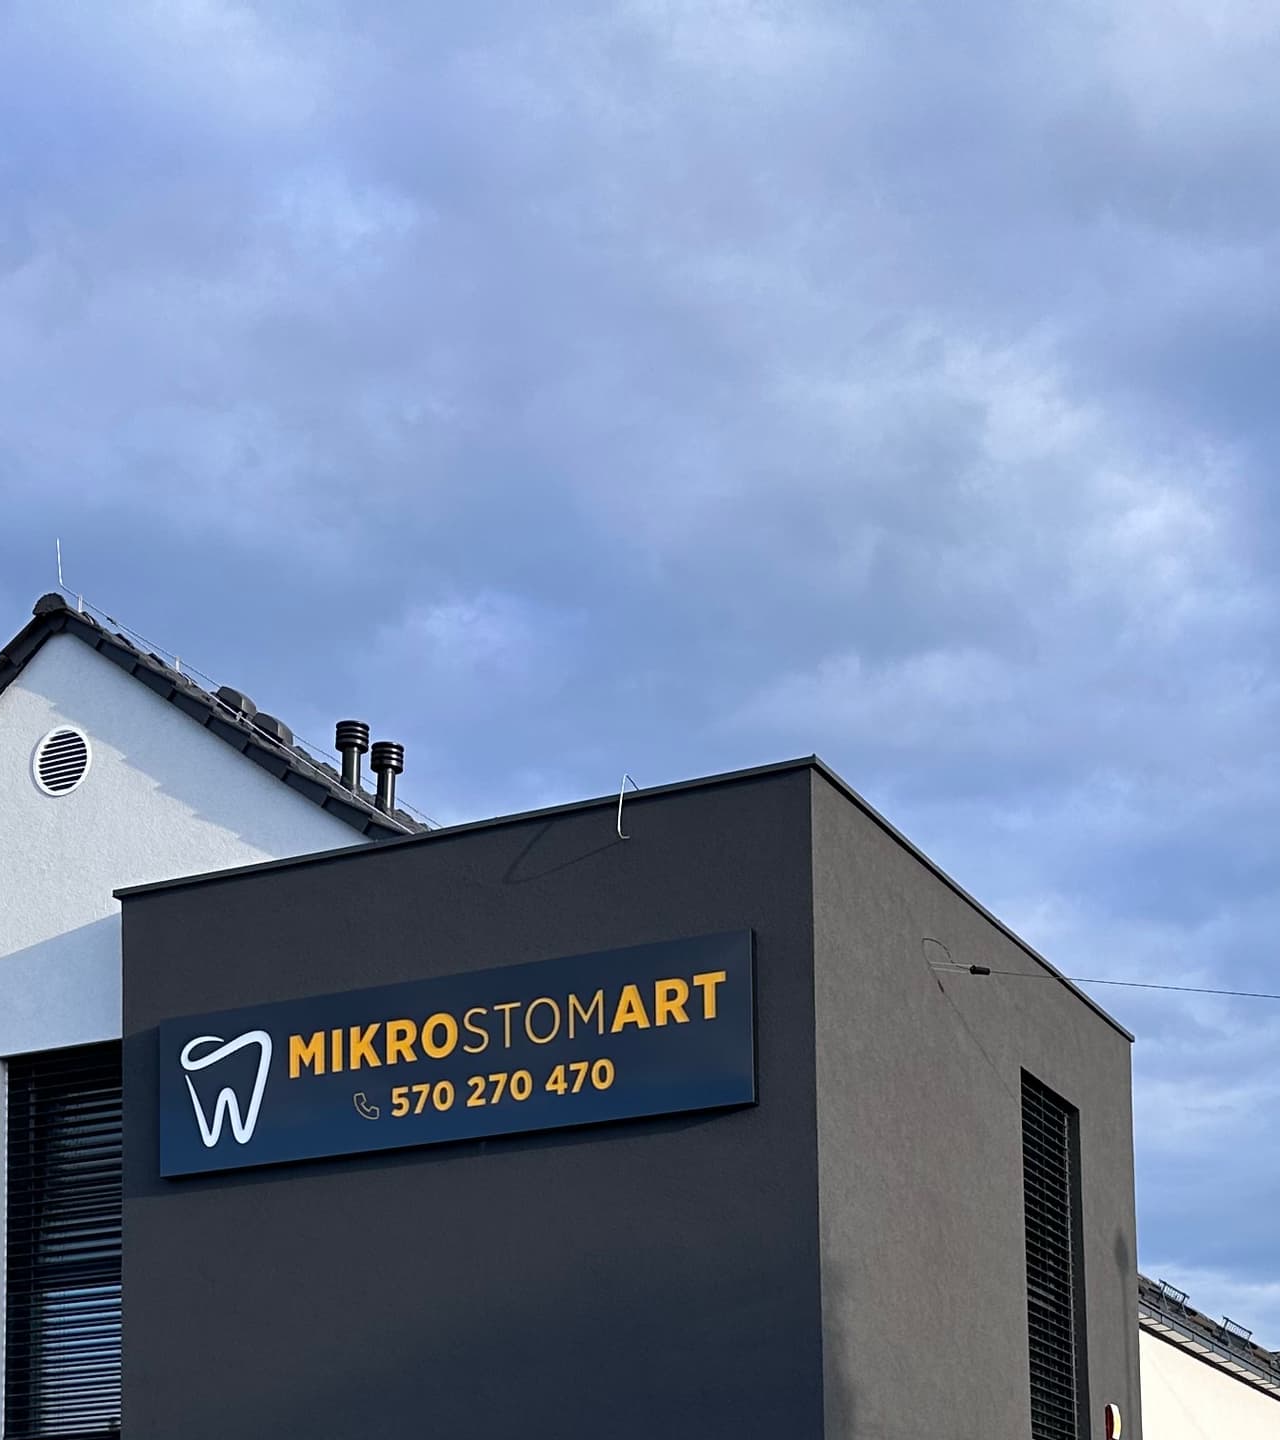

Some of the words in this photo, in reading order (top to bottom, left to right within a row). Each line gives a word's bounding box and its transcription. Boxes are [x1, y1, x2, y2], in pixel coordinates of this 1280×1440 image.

[289, 971, 726, 1078] MIKROSTOMART
[391, 1081, 455, 1117] 570
[466, 1071, 533, 1107] 270
[545, 1058, 615, 1096] 470
